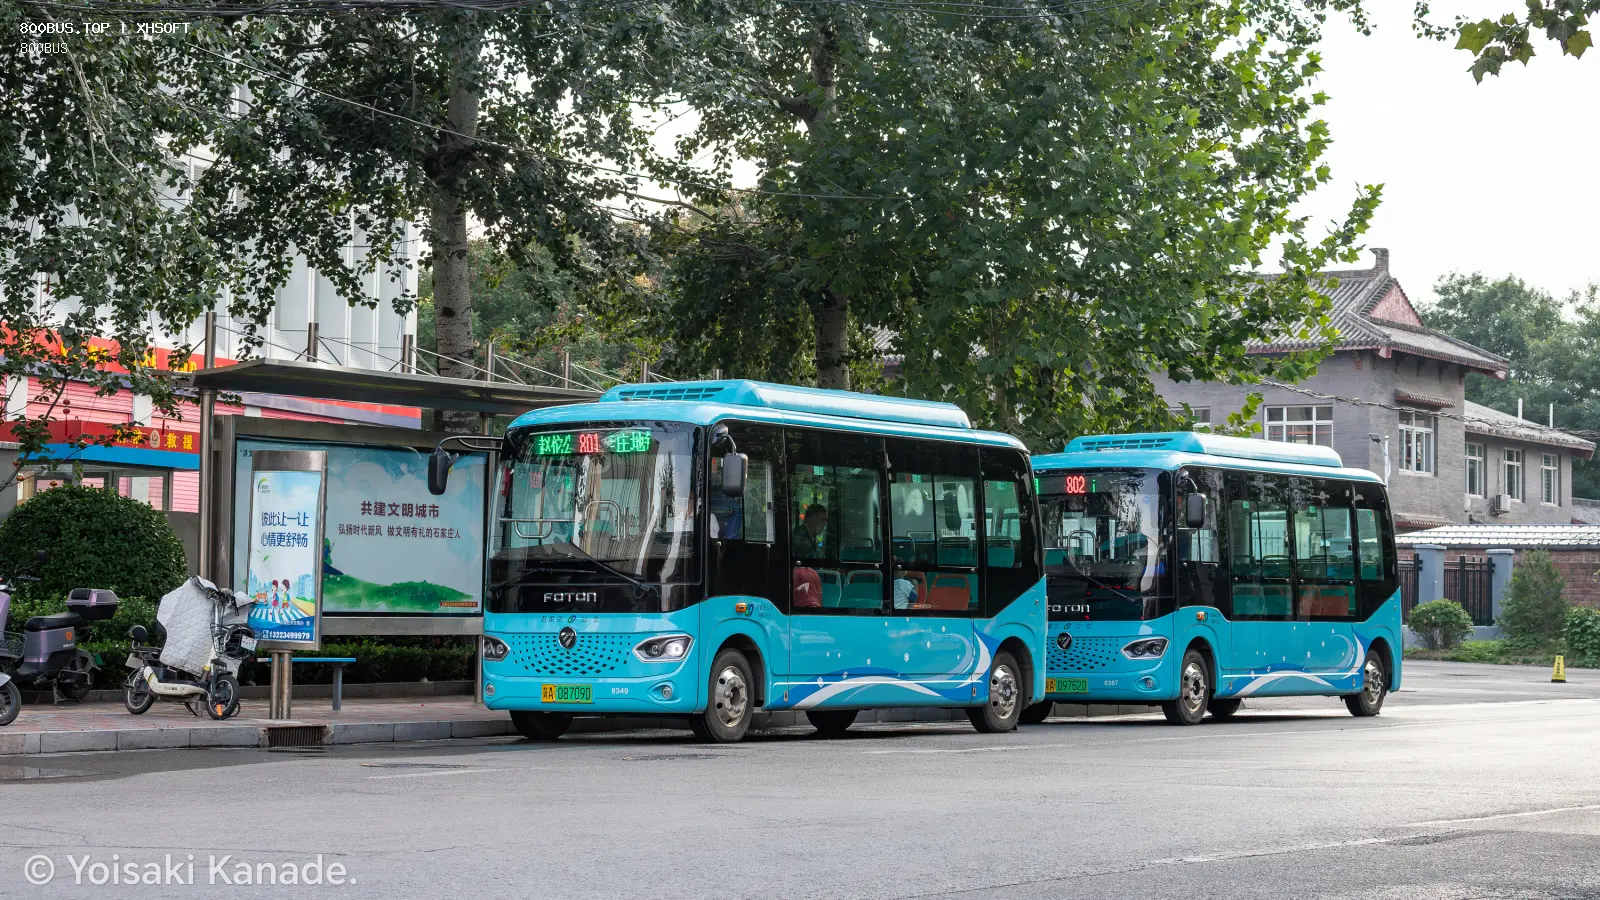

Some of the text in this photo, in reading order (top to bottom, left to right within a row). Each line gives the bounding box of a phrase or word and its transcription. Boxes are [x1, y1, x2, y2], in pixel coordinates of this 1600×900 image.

[167, 433, 193, 450] 救援
[580, 433, 599, 453] 801
[1066, 476, 1085, 493] 802
[360, 501, 440, 519] 共建文明城市
[261, 511, 309, 527] 彼此让一让
[338, 523, 461, 539] 弘扬时代新风 做文明有礼的石家庄人
[261, 532, 308, 547] 心情更舒畅
[543, 592, 597, 602] FOTON
[269, 631, 310, 639] 13223499979
